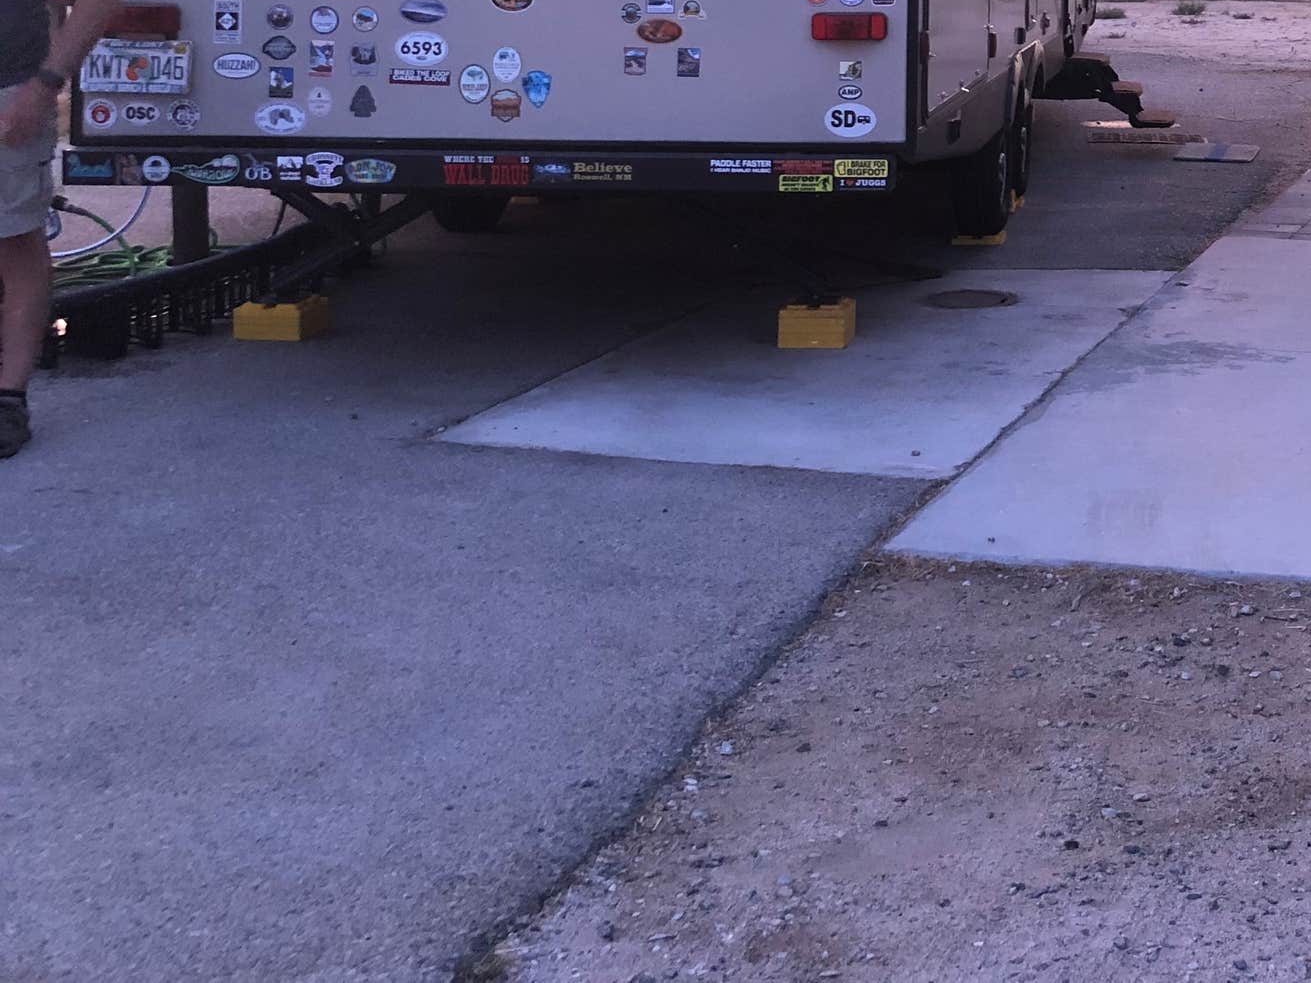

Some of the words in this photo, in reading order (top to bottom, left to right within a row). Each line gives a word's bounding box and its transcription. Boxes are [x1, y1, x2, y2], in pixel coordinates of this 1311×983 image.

[400, 41, 442, 56] 6593
[126, 106, 156, 120] OSC
[831, 109, 856, 128] SD
[444, 165, 486, 184] WALL
[491, 165, 529, 184] DRUG
[573, 162, 633, 173] Believe
[847, 168, 886, 176] BIGFOOT
